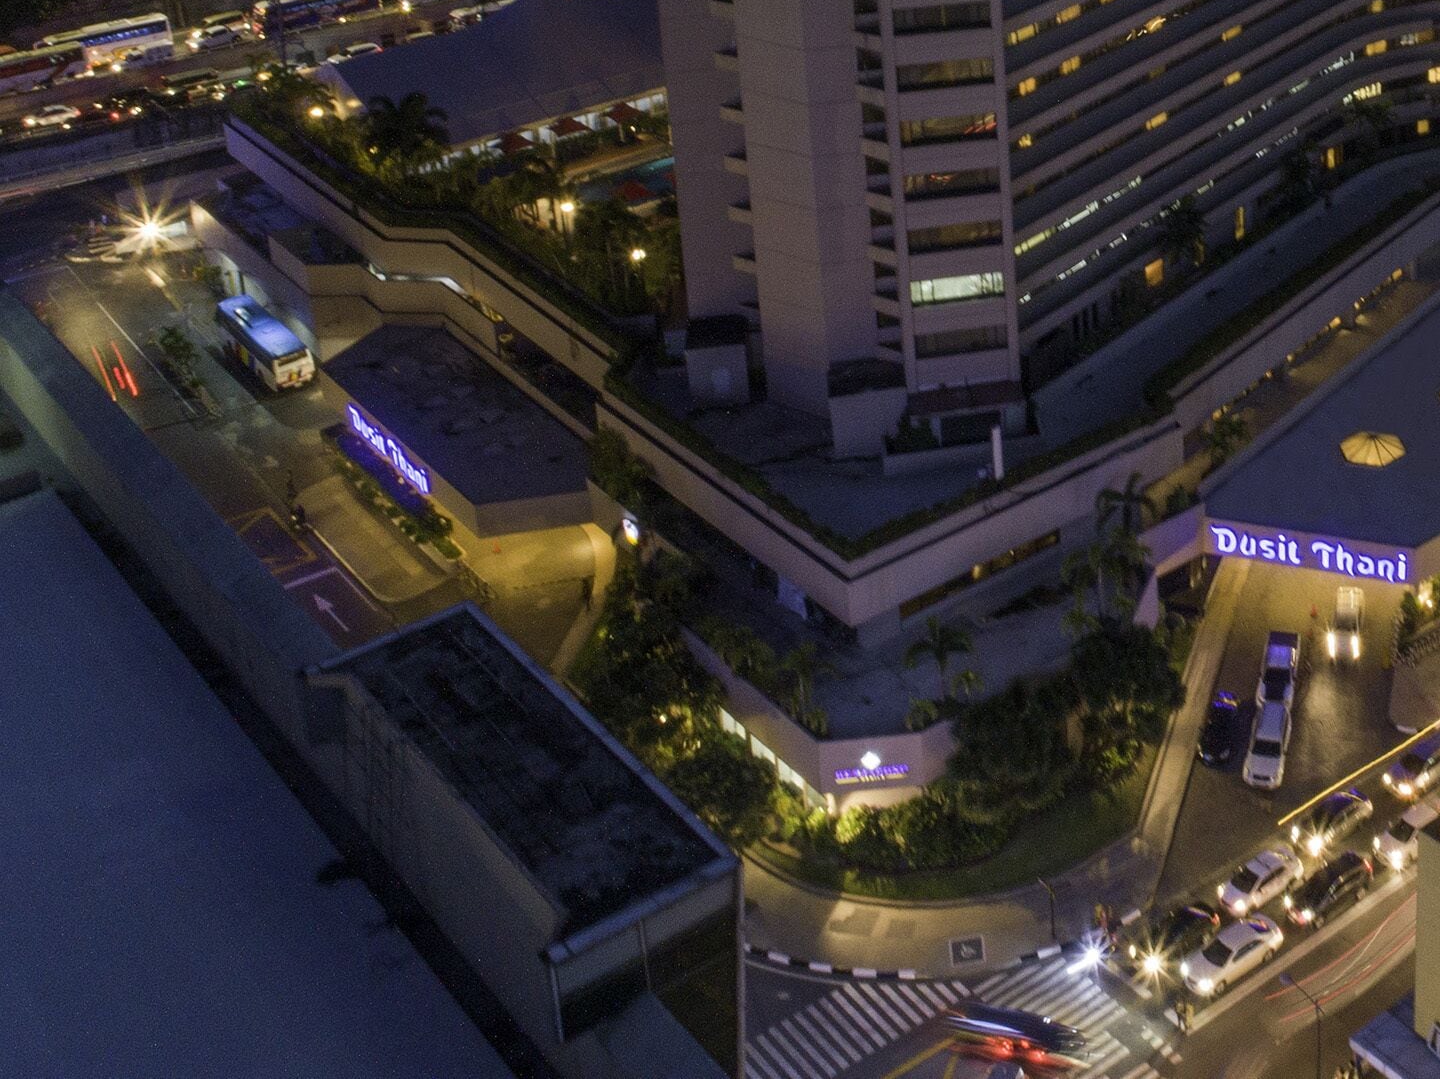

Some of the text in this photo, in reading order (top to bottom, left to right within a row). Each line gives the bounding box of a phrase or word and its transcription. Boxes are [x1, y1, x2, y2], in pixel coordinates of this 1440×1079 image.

[347, 404, 430, 495] Dusit Thani
[1210, 524, 1408, 584] Dusit Thani
